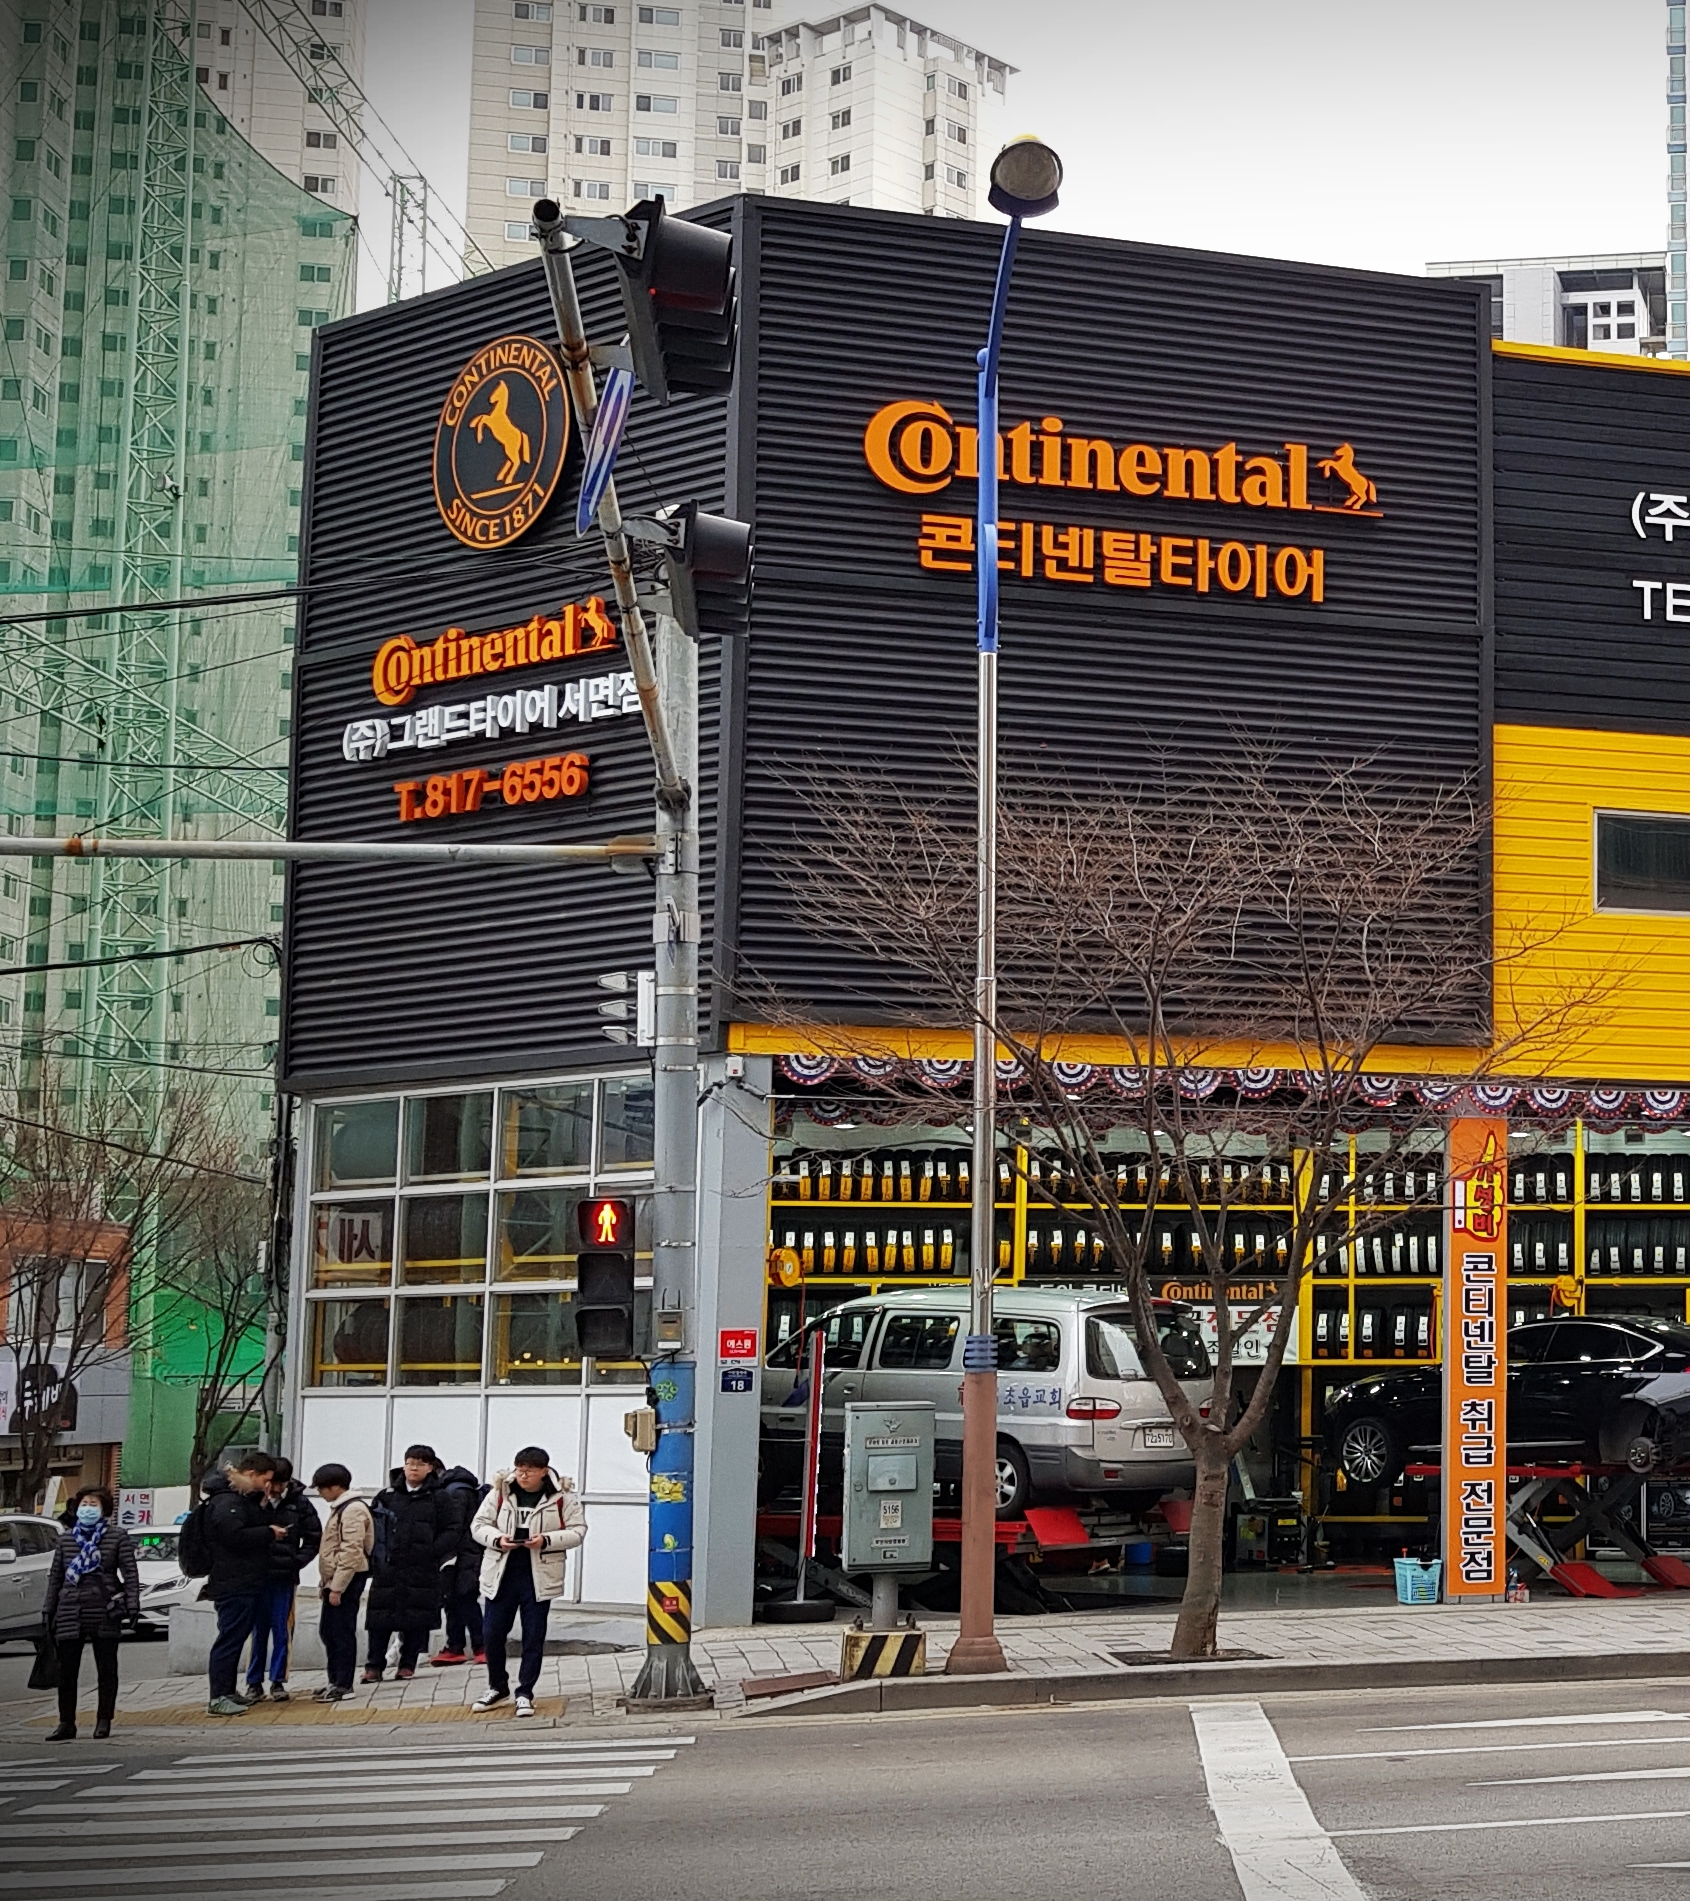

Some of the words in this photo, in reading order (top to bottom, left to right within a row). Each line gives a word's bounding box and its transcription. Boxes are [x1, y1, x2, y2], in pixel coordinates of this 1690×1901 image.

[444, 343, 558, 427] CONTINENTAL
[447, 497, 500, 541] SINCE
[503, 481, 546, 536] 1871
[917, 513, 1326, 604] 콘티넨탈타이어
[370, 603, 581, 707] Continental
[393, 752, 592, 822] T.817-6556
[1161, 1281, 1264, 1300] Contintal
[1463, 1253, 1497, 1386] 콘티넨탈
[730, 1380, 745, 1391] 18
[1003, 1386, 1062, 1411] 초읍교회
[1460, 1399, 1496, 1467] 취급
[1460, 1480, 1495, 1583] 전문점
